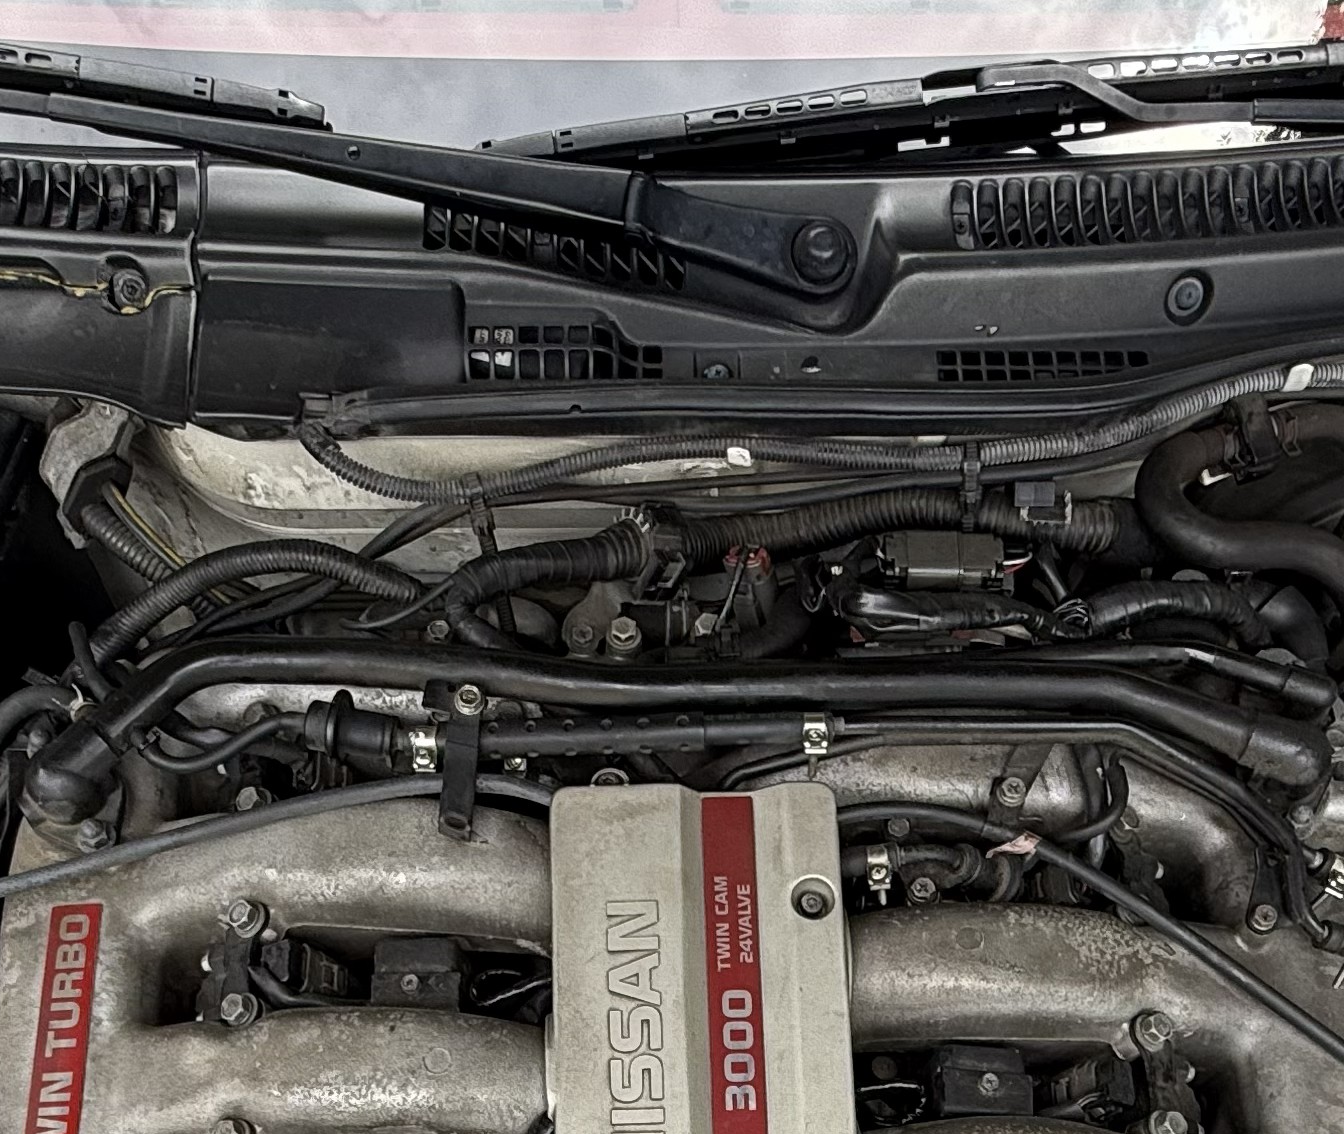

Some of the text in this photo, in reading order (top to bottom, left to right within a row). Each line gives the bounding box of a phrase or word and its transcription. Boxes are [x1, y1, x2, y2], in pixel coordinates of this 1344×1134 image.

[713, 876, 731, 972] TWIN CAM
[736, 884, 754, 964] 24VALVE
[45, 913, 90, 1058] TURBO
[721, 989, 757, 1111] 3000
